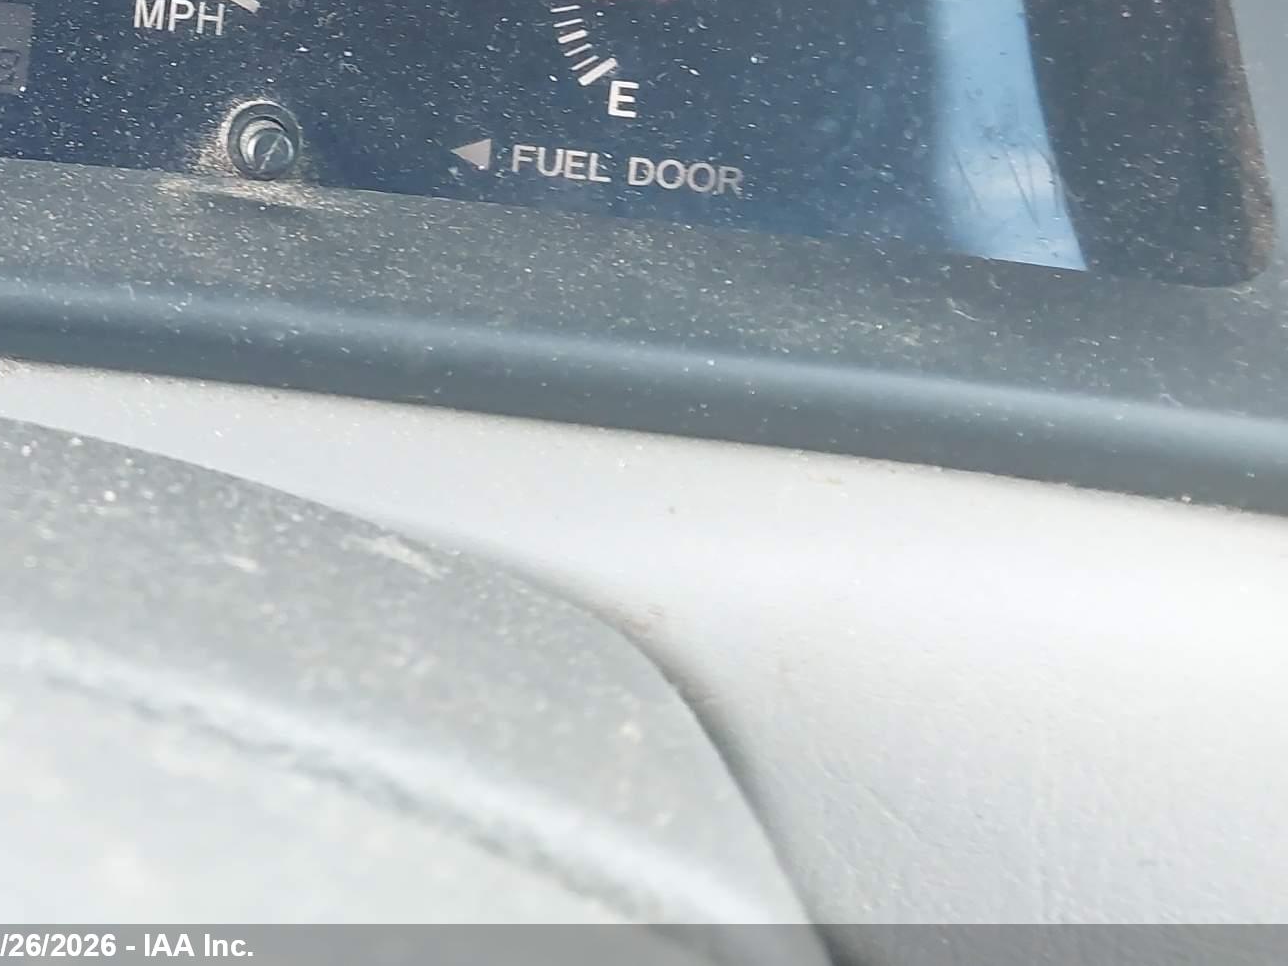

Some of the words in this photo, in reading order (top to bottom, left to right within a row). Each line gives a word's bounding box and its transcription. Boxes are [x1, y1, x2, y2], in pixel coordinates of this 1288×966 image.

[609, 81, 637, 117] E
[512, 143, 610, 182] FUEL
[627, 155, 742, 195] DOOR
